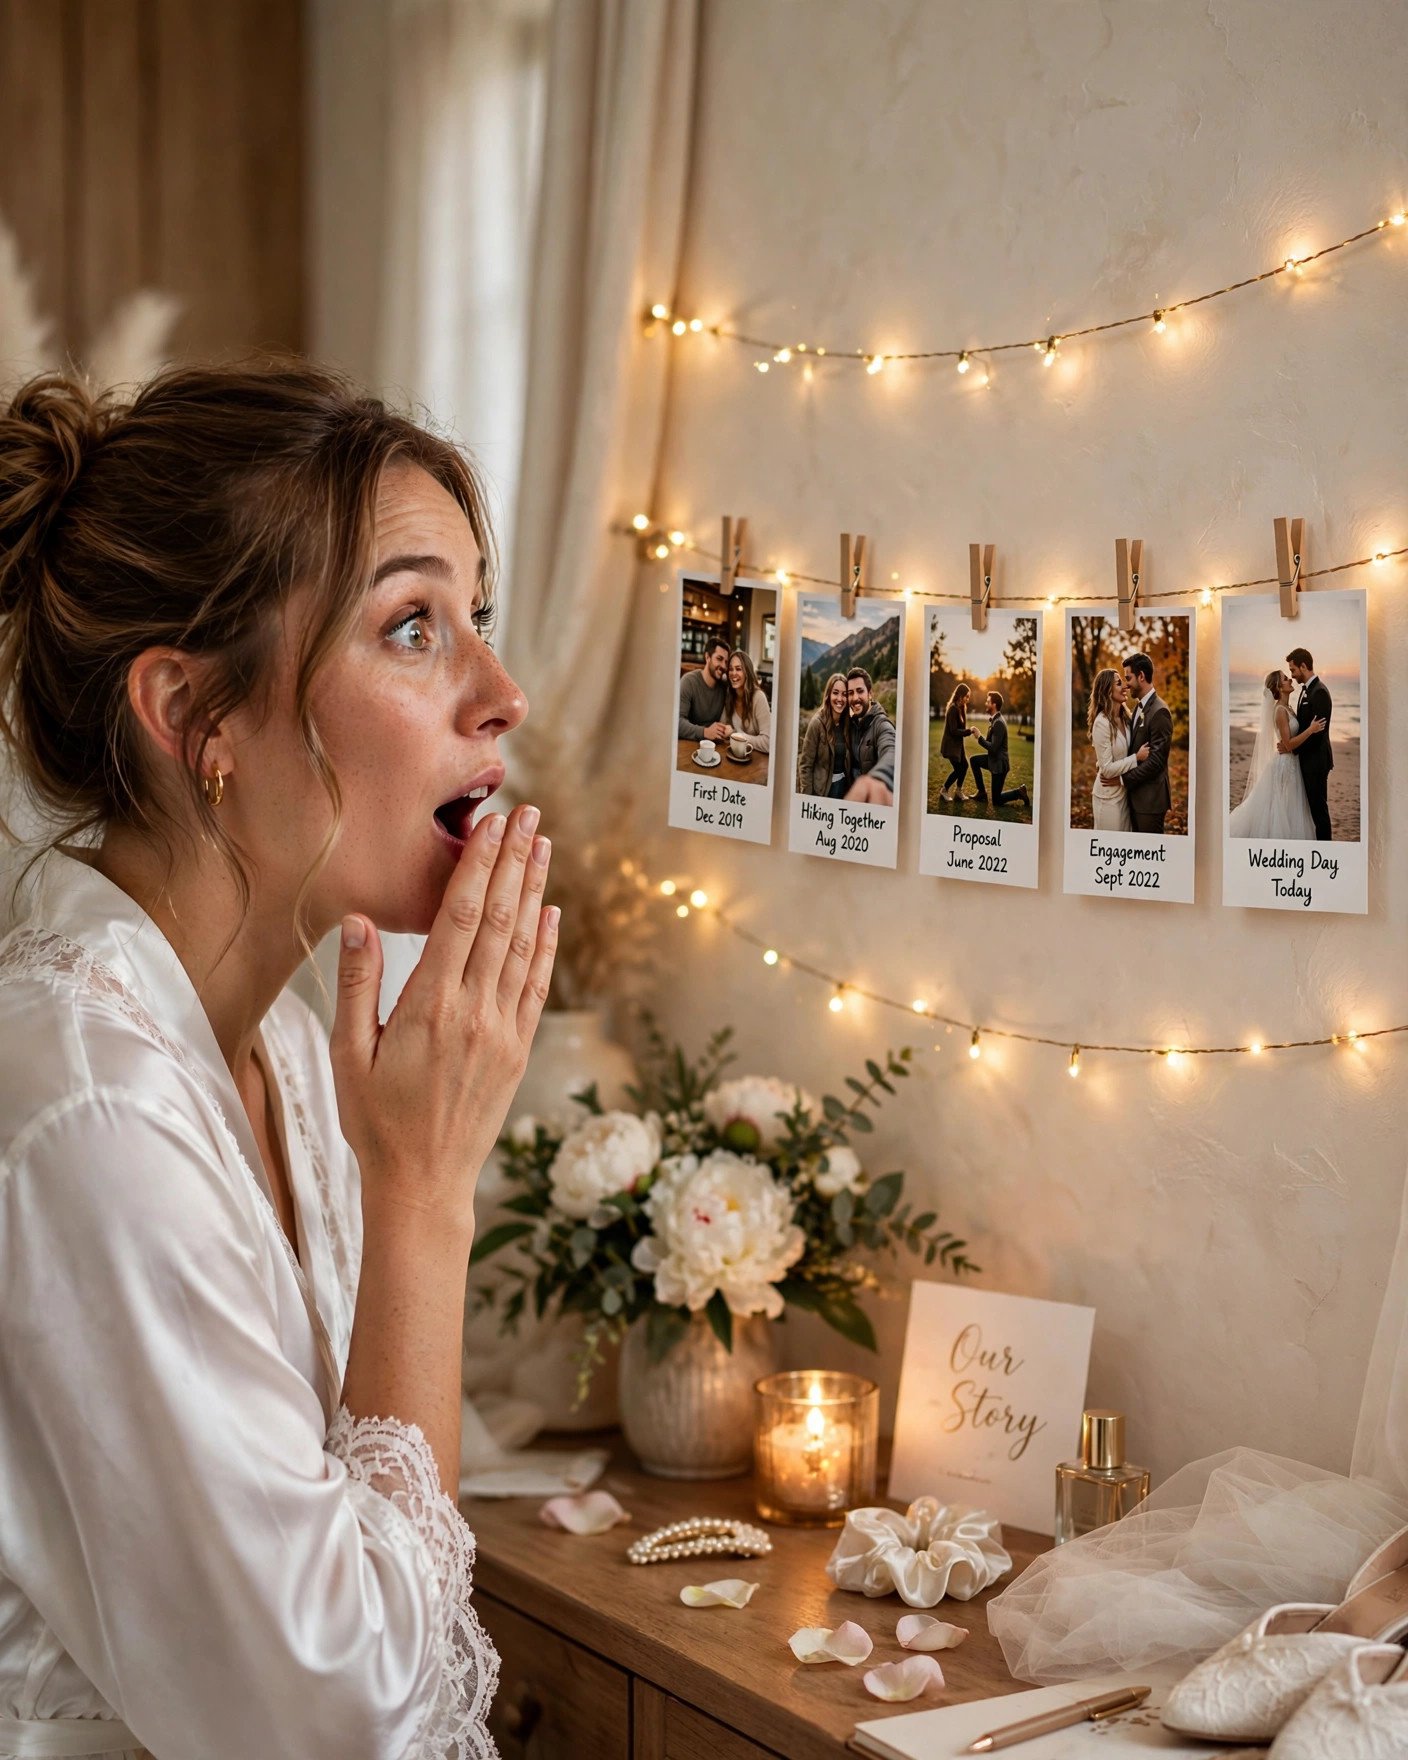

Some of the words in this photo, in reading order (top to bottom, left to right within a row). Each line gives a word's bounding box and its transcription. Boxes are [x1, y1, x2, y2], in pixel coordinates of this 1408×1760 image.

[692, 781, 717, 803] First
[721, 786, 747, 807] Date
[695, 806, 714, 825] Dec
[718, 811, 743, 829] 2019
[801, 802, 834, 830] Hiking
[838, 807, 886, 834] Together
[815, 830, 837, 855] Aug
[841, 834, 869, 853] 2020
[953, 824, 1002, 849] Proposal
[946, 850, 974, 870] June
[978, 855, 1008, 873] 2022
[1089, 838, 1166, 867] Engagement
[1248, 848, 1304, 878] Wedding
[1311, 850, 1340, 880] Day
[1094, 866, 1123, 891] Sept
[1128, 871, 1160, 889] 2022
[1271, 878, 1312, 907] Today
[950, 1323, 1024, 1376] Our
[942, 1380, 1047, 1462] Story
